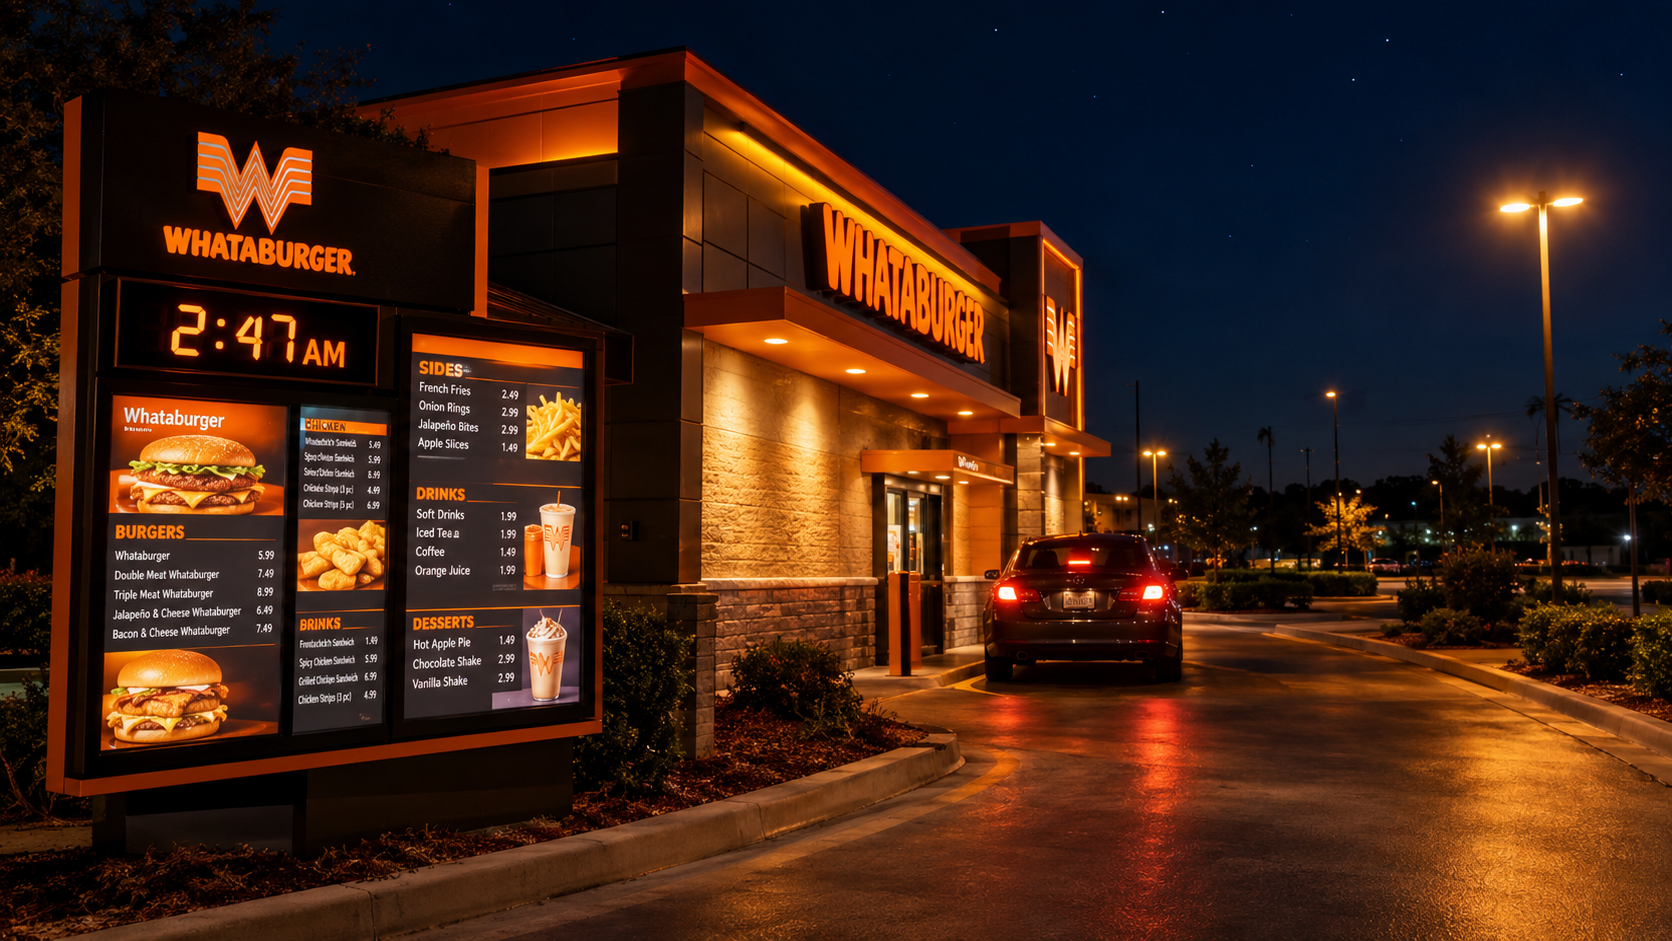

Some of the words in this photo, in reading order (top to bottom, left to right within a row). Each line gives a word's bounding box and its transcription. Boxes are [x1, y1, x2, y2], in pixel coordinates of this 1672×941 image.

[163, 225, 356, 276] WHATABURGER
[822, 202, 985, 364] WHATABURGER
[171, 304, 296, 363] 2:47
[302, 338, 345, 367] AM
[419, 361, 463, 378] SIDES
[420, 382, 448, 394] French
[451, 384, 471, 396] Fries
[502, 390, 519, 400] 2.49
[419, 400, 444, 412] Onion
[448, 403, 470, 416] Rings
[502, 408, 518, 417] 2.99
[124, 407, 224, 430] Whataburger
[418, 419, 456, 431] Jalapeño
[459, 422, 478, 432] Bites
[502, 425, 518, 435] 2.99
[418, 438, 442, 450] Apple
[446, 439, 469, 450] Slices
[502, 443, 518, 452] 1.49
[416, 487, 465, 501] DRINKS
[417, 509, 435, 519] Soft
[438, 509, 464, 520] Drinks
[501, 512, 517, 521] 1.99
[115, 525, 185, 540] BURGERS
[417, 527, 434, 538] Iced
[437, 528, 452, 538] Tea
[501, 530, 516, 539] 1.99
[115, 550, 170, 562] Whataburger
[258, 550, 275, 560] 5.99
[416, 546, 444, 557] Coffee
[500, 547, 516, 557] 1.49
[114, 570, 144, 580] Double
[146, 570, 167, 580] Meat
[168, 569, 219, 581] Whataburger
[258, 569, 274, 578] 7.49
[415, 565, 446, 578] Orange
[449, 566, 470, 576] Juice
[500, 565, 516, 575] 1.99
[114, 589, 138, 602] Triple
[139, 589, 161, 600] Meat
[163, 588, 214, 600] Whataburger
[257, 587, 273, 596] 8.99
[113, 608, 150, 621] Jalapeño
[153, 608, 160, 618] &
[161, 608, 190, 618] Cheese
[192, 606, 241, 619] Whataburger
[256, 606, 273, 615] 6.49
[413, 615, 474, 630] DESSERTS
[113, 629, 138, 639] Bacon
[140, 628, 147, 638] &
[149, 627, 179, 638] Cheese
[180, 625, 230, 638] Whataburger
[256, 624, 272, 633] 7.49
[414, 639, 429, 650] Hot
[432, 638, 455, 651] Apple
[458, 637, 471, 647] Pie
[499, 635, 515, 645] 1.49
[413, 657, 455, 670] Chocolate
[458, 655, 482, 666] Shake
[498, 654, 515, 664] 2.99
[413, 678, 441, 689] Vanilla
[443, 675, 468, 686] Shake
[498, 672, 515, 683] 2.99
